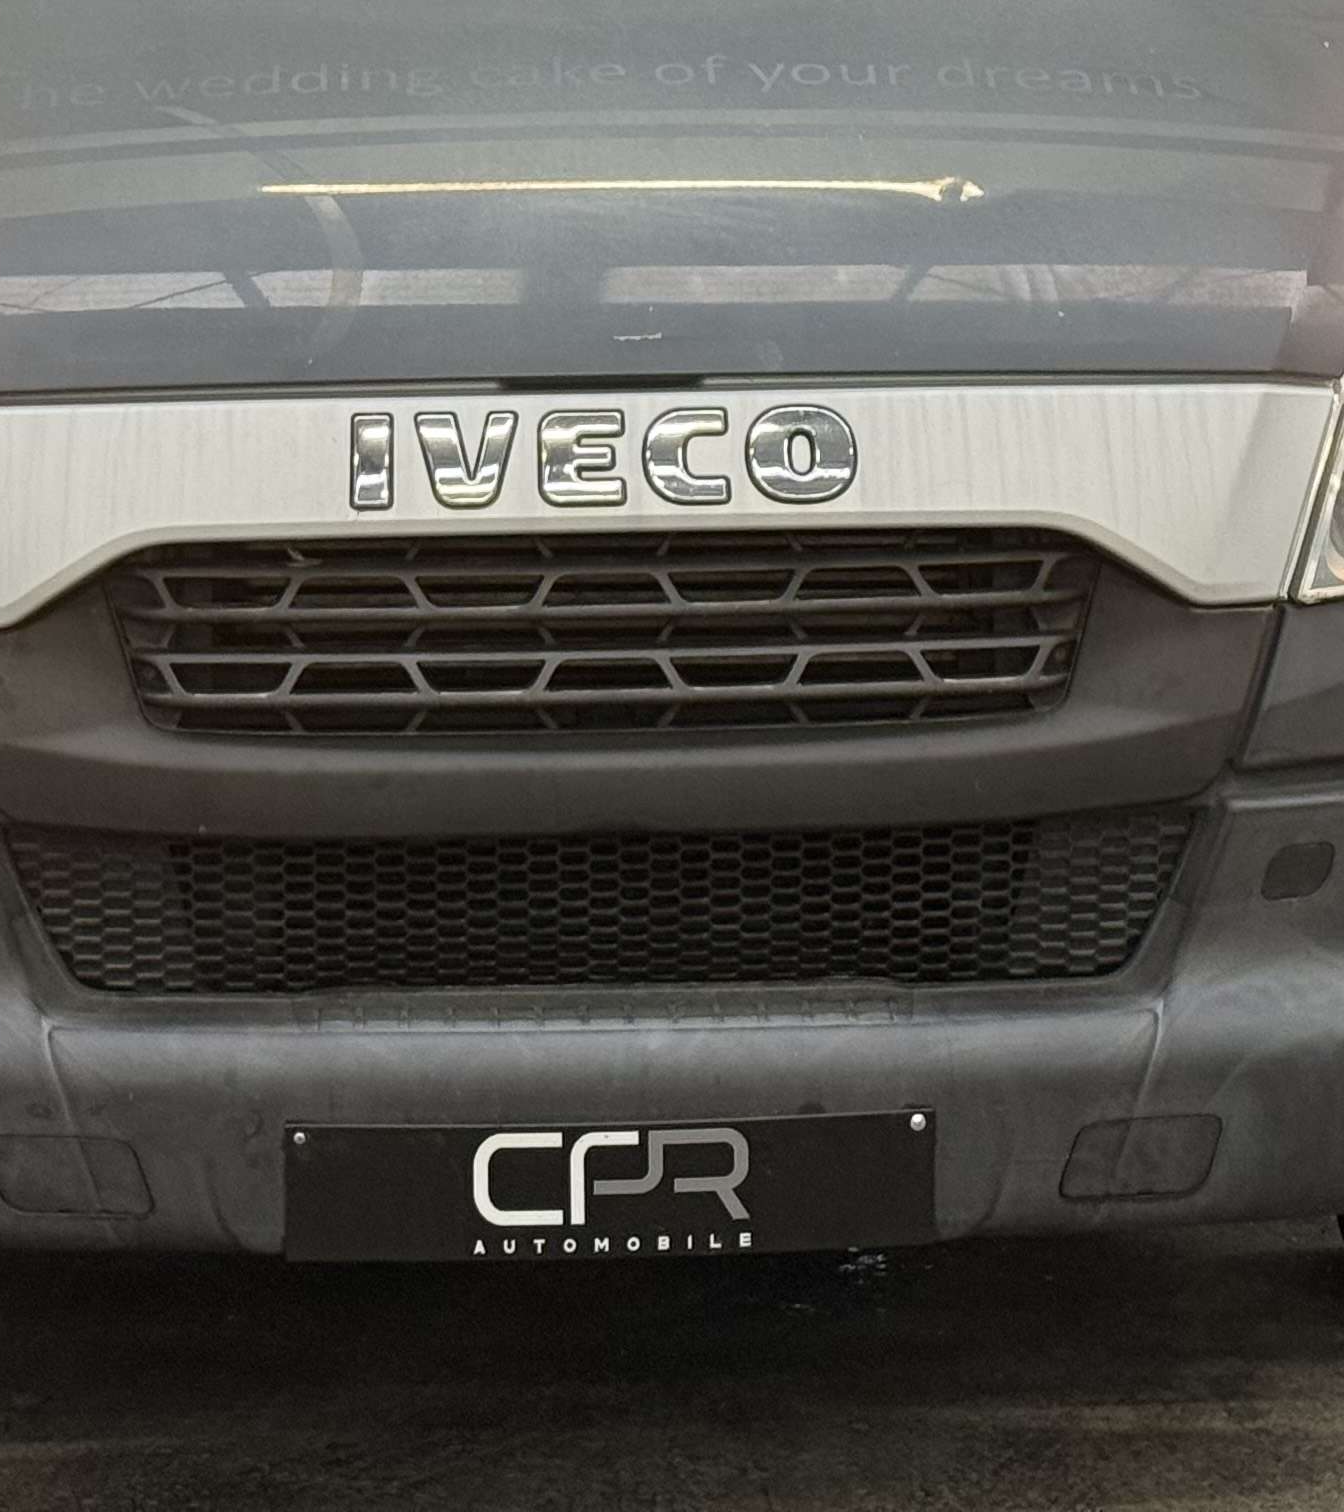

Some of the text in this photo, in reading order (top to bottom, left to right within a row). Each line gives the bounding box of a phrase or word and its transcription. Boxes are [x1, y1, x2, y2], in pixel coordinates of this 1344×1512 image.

[134, 62, 445, 101] wedding
[470, 56, 626, 89] cake
[655, 55, 728, 86] of
[746, 59, 911, 92] your
[937, 56, 1203, 100] dreams
[350, 404, 858, 510] IVECO
[472, 1127, 750, 1226] CPR
[472, 1232, 752, 1256] AUTOMOBILE
